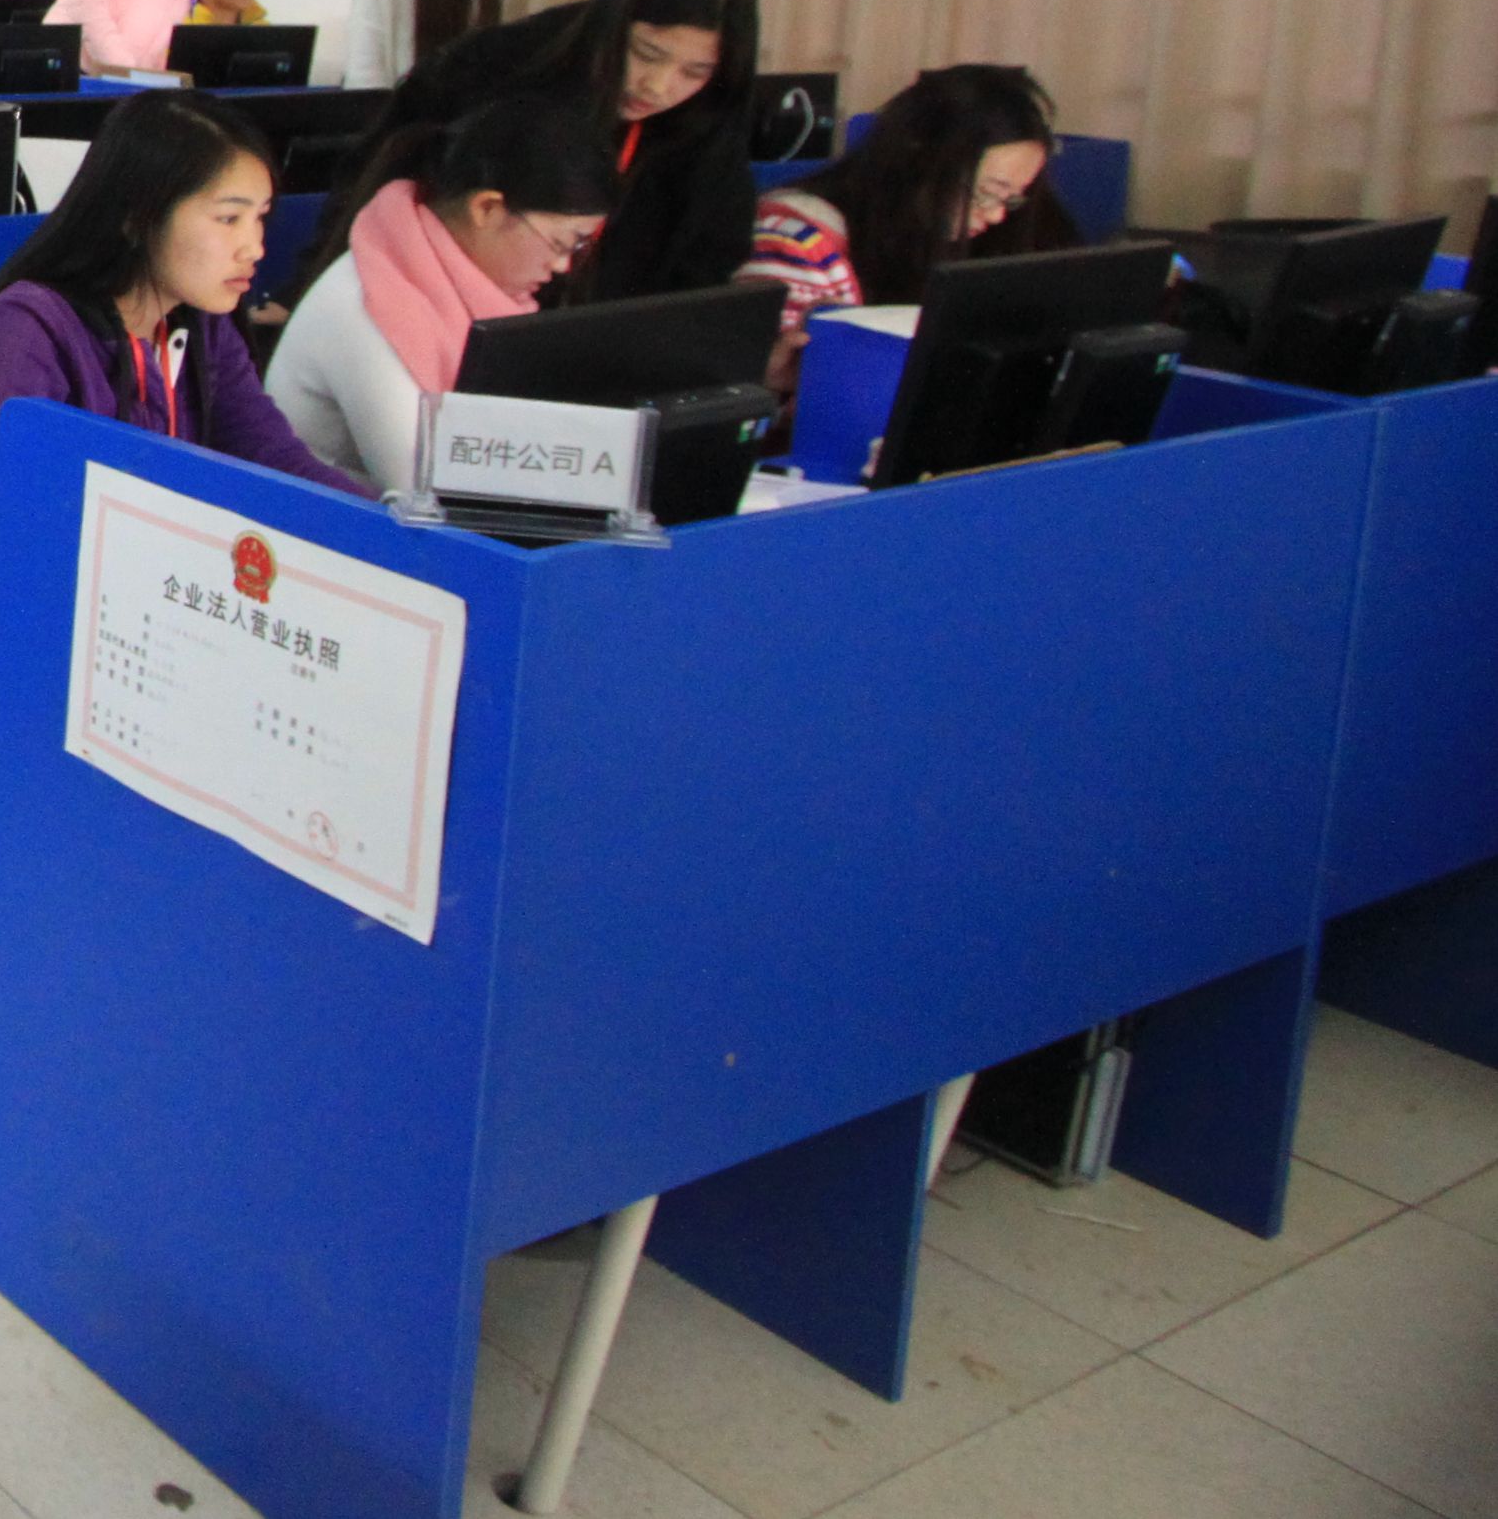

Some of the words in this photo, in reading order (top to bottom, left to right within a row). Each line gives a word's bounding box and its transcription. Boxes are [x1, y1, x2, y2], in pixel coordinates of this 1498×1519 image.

[450, 435, 583, 476] 配件公司
[591, 451, 616, 477] A
[162, 574, 341, 671] 企业法人营业执照
